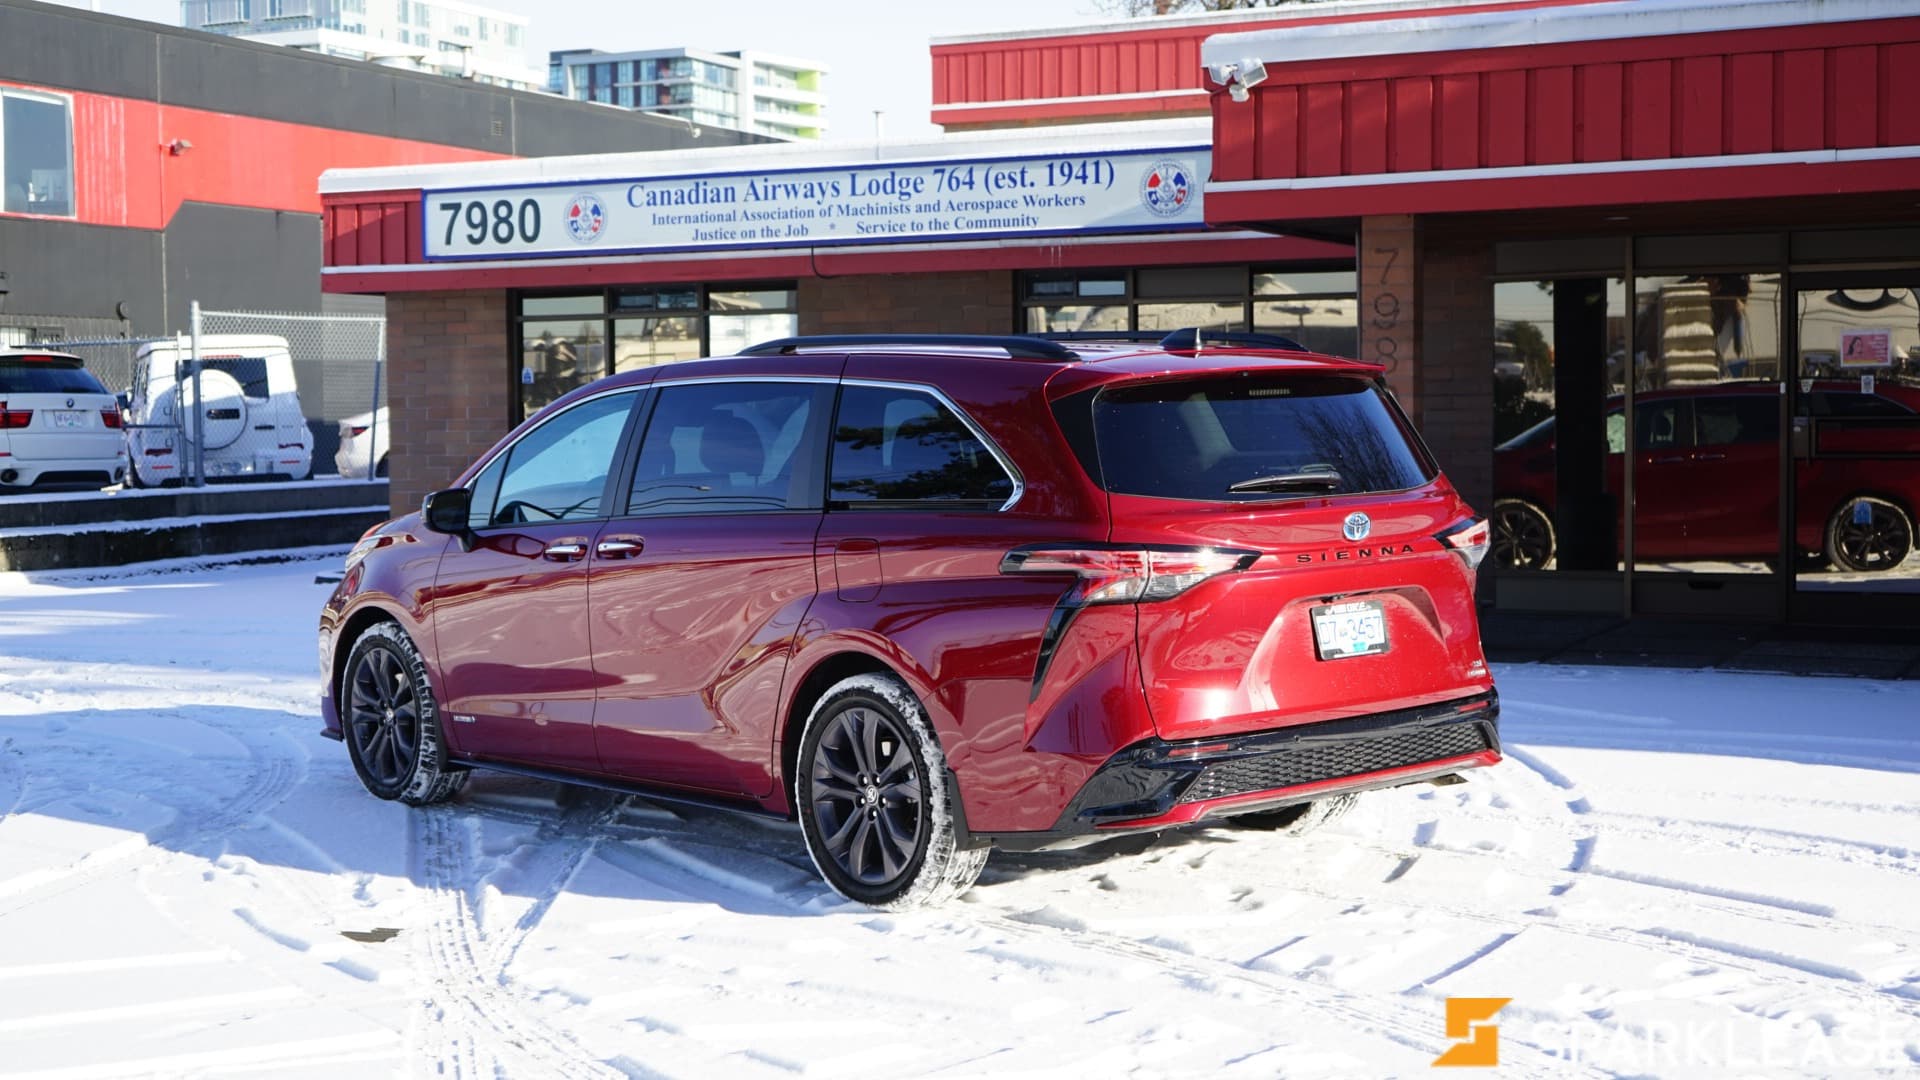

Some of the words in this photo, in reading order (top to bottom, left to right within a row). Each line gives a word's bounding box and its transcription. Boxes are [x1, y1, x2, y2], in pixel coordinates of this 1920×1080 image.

[627, 181, 736, 208] Canadian
[743, 177, 840, 205] Airways
[849, 170, 924, 201] Lodge
[933, 165, 975, 192] 764
[984, 165, 1035, 196] (est.
[1045, 159, 1114, 190] 1941)
[439, 198, 541, 245] 7980
[652, 209, 736, 226] International
[741, 206, 815, 222] Association
[820, 204, 833, 218] of
[837, 202, 911, 217] Machinists
[915, 200, 940, 213] and
[945, 198, 1018, 213] Aerospace
[1022, 193, 1086, 208] Workers
[692, 228, 737, 241] Justice
[740, 229, 756, 239] on
[760, 225, 781, 238] the
[785, 224, 809, 237] Job
[856, 220, 906, 234] Service
[910, 221, 924, 232] to
[928, 217, 950, 230] the
[954, 213, 1039, 230] Community
[1374, 247, 1400, 396] 798
[1297, 544, 1414, 563] SIENNA
